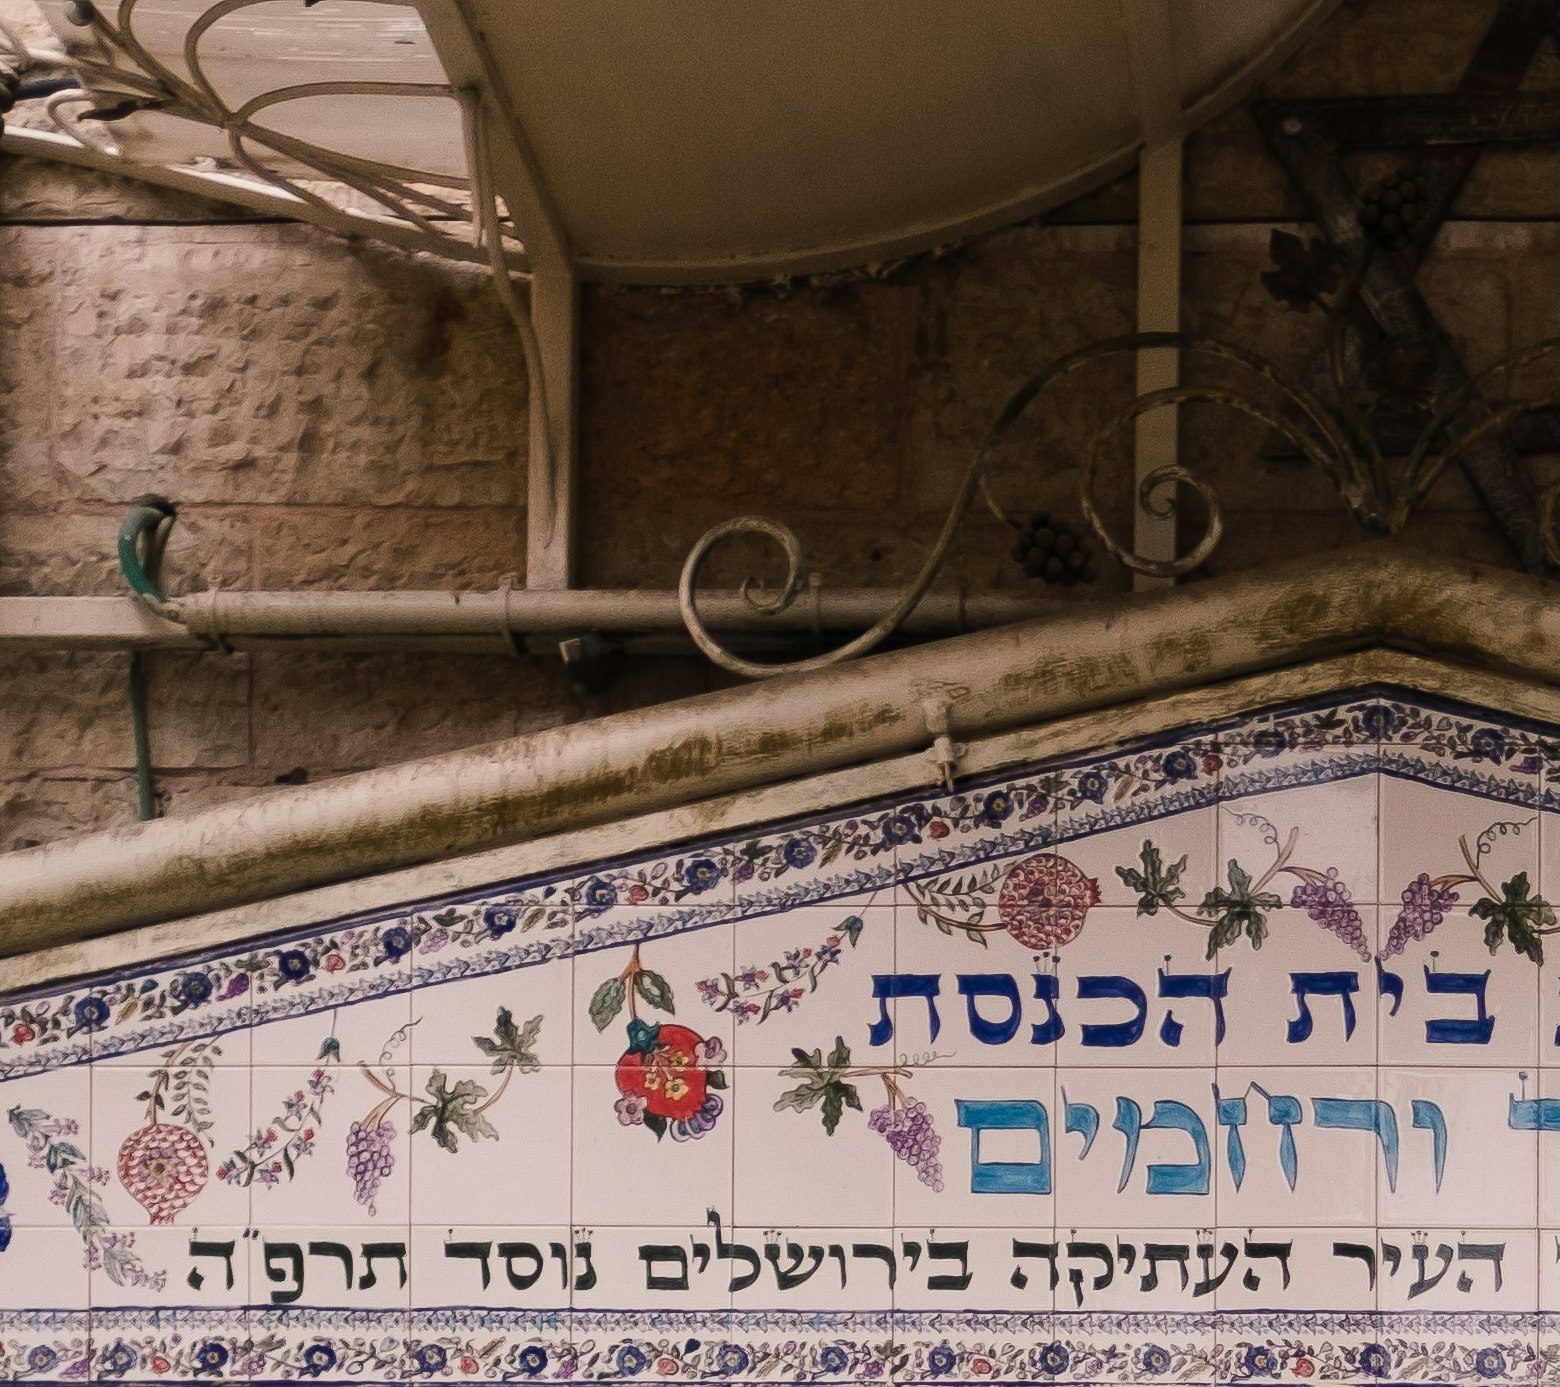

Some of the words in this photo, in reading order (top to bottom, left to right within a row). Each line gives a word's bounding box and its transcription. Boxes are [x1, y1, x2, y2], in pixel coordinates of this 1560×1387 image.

[869, 955, 1231, 1047] הכנסת
[1288, 955, 1494, 1046] בית
[956, 1082, 1446, 1194] ורחמים
[445, 1229, 596, 1290] נוסד
[639, 1213, 973, 1291] בירושלים
[1012, 1229, 1295, 1307] העתיקה
[1332, 1231, 1506, 1299] העיר
